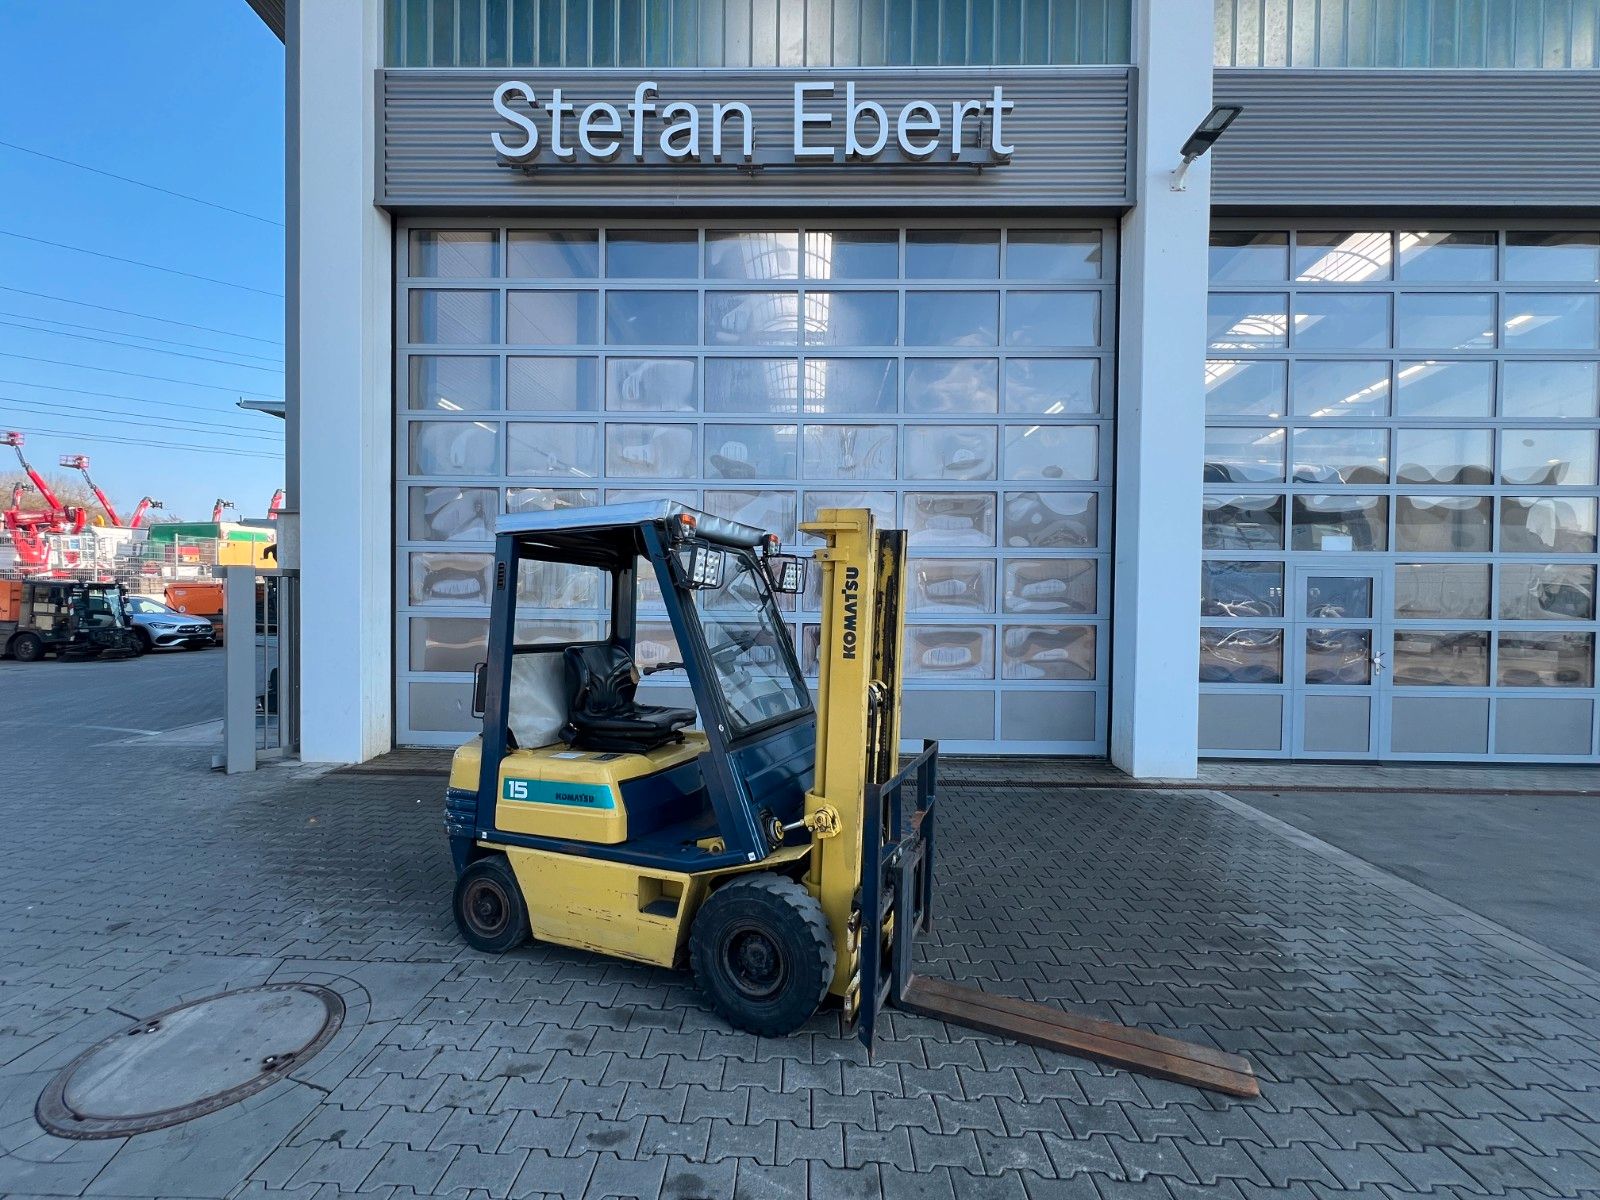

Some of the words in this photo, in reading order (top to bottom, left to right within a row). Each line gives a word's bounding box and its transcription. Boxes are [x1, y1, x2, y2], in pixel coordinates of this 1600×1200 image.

[491, 80, 753, 159] Stefan
[794, 80, 1015, 159] Ebert
[842, 566, 859, 660] KOMATSU
[508, 780, 528, 799] 15
[555, 792, 595, 803] KOMATSU
